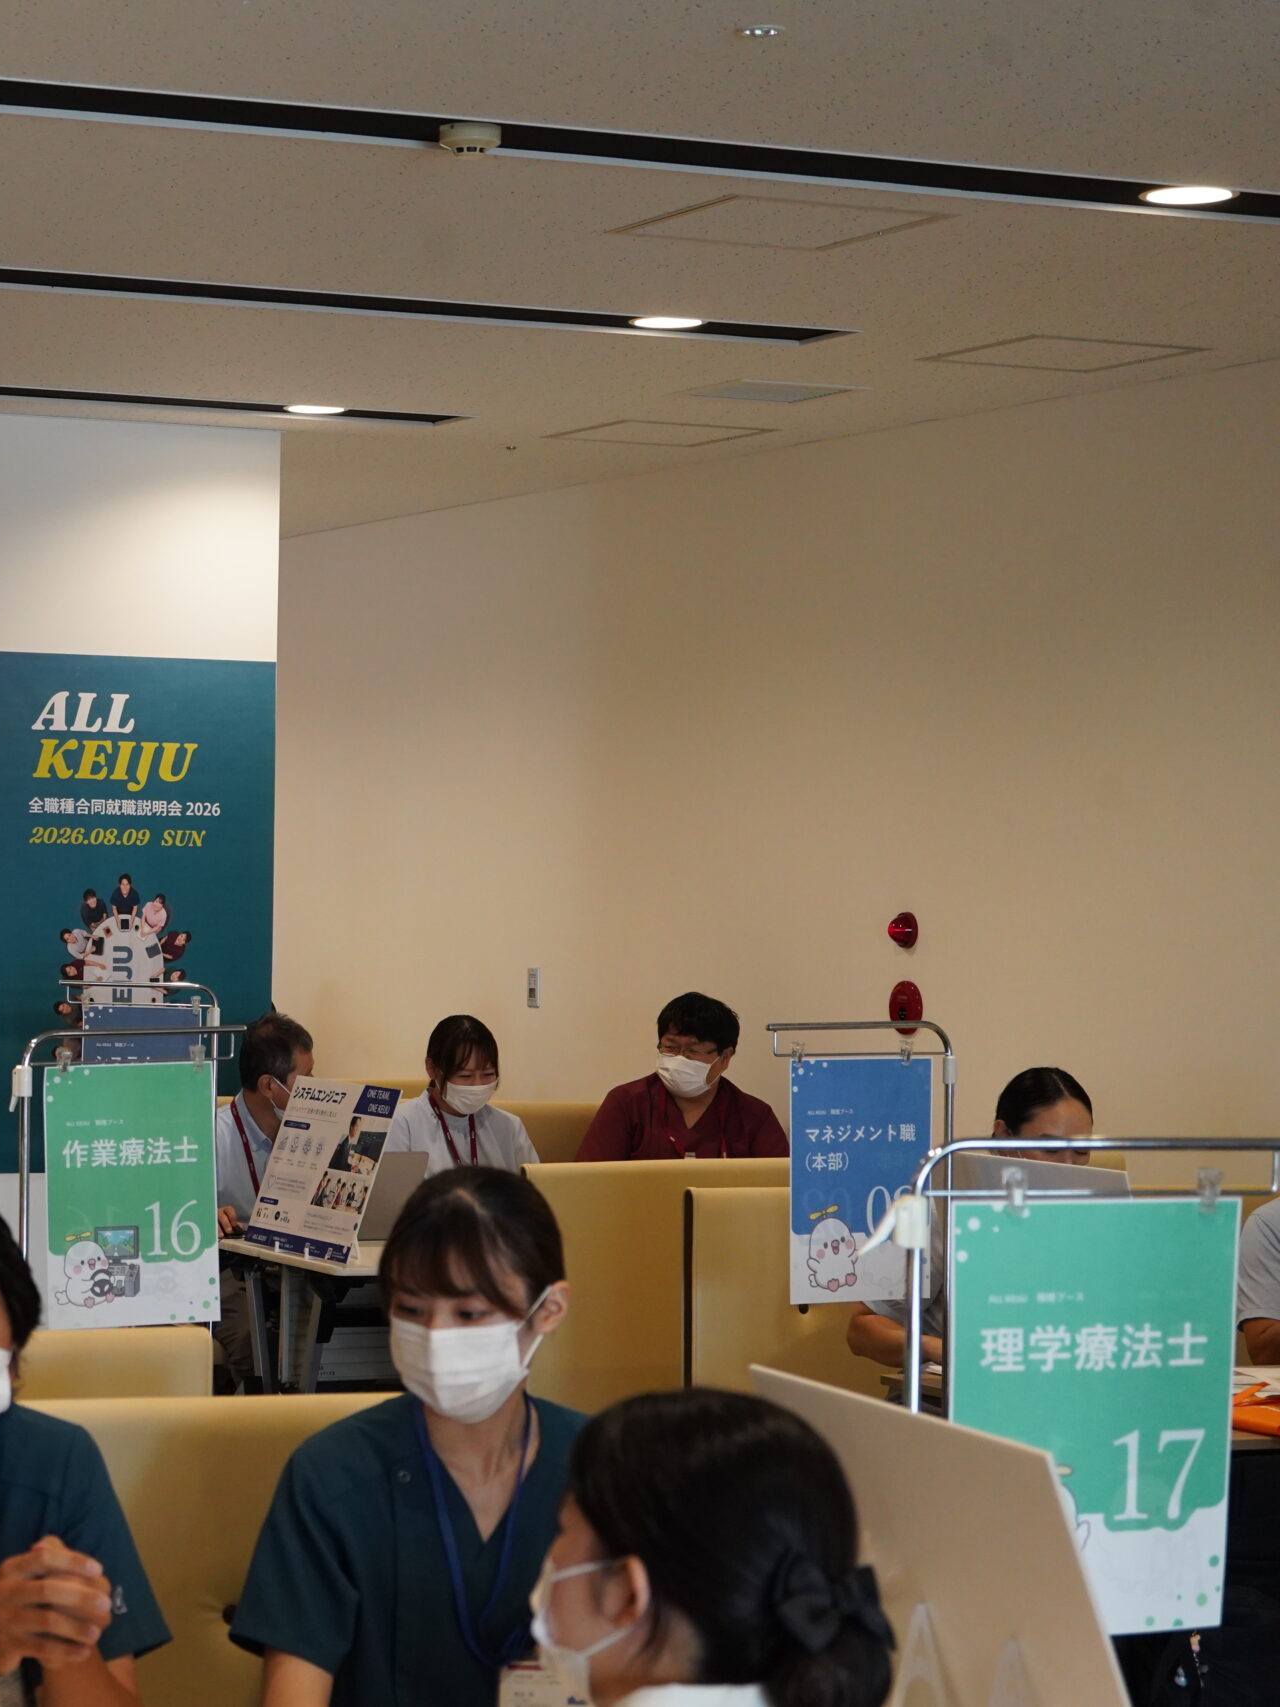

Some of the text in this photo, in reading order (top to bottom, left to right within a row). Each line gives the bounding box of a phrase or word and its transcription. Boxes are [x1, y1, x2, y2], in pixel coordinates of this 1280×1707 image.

[31, 691, 135, 734] ALL
[32, 738, 199, 792] KEIJU
[28, 797, 221, 817] 全職種合同就職説明会 2026
[28, 826, 207, 847] 2026.08.09 SUN
[293, 1086, 347, 1105] システムエンジニア
[367, 1089, 377, 1098] ONE
[367, 1103, 378, 1112] ONE
[805, 1123, 916, 1144] マネジメント職
[62, 1136, 199, 1169] 作業療法士
[805, 1151, 849, 1172] (本部)
[866, 1185, 913, 1235] 0
[144, 1199, 201, 1257] 16
[980, 1321, 1208, 1373] 理学療法士
[1113, 1428, 1206, 1521] 17
